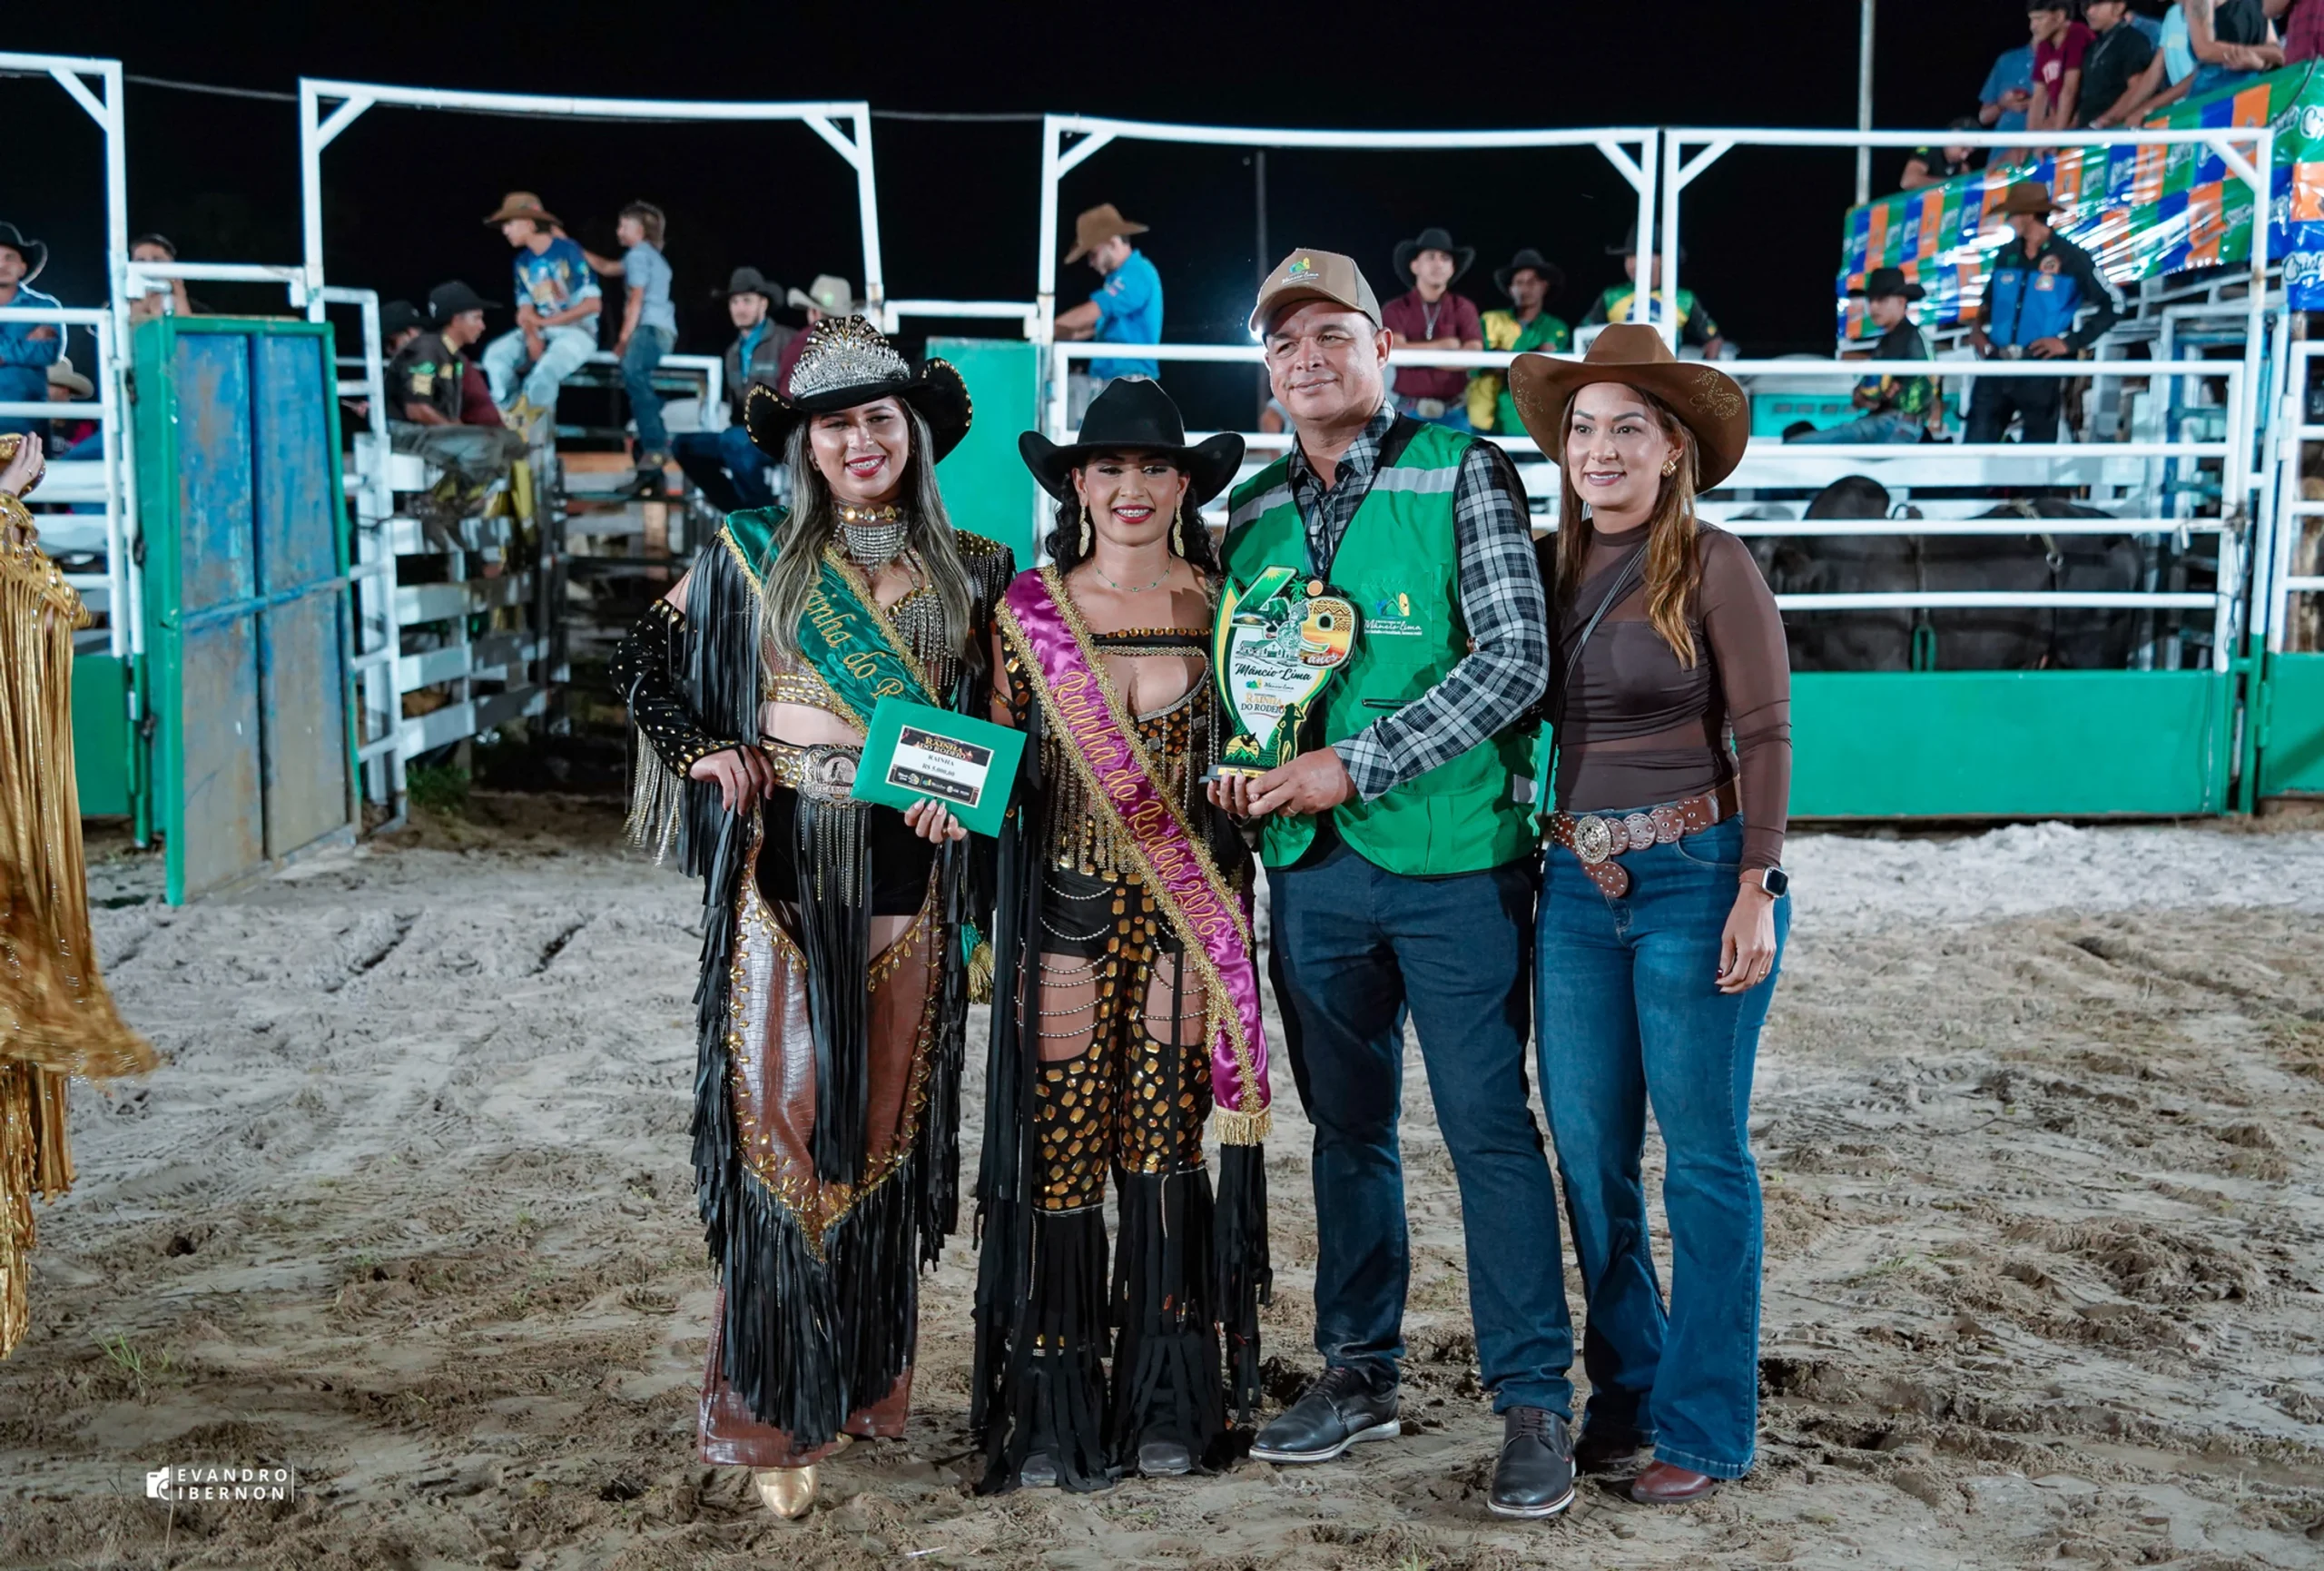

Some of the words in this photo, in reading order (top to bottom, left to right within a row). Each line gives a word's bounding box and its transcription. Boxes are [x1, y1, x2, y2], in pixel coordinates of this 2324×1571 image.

[843, 651, 887, 679] do
[1307, 652, 1339, 665] anos
[1235, 663, 1277, 677] Mâncio
[1279, 667, 1313, 681] Lima
[1246, 692, 1283, 706] RAINHA
[1241, 703, 1253, 711] DO
[1255, 703, 1285, 715] RODEIO
[920, 743, 933, 751] DO
[925, 736, 962, 754] RAINHA
[928, 755, 954, 766] RAINHA
[1052, 671, 1118, 765] Rainha
[1104, 769, 1142, 802] do
[1128, 800, 1186, 881] Rodeio
[1174, 879, 1227, 936] 2026
